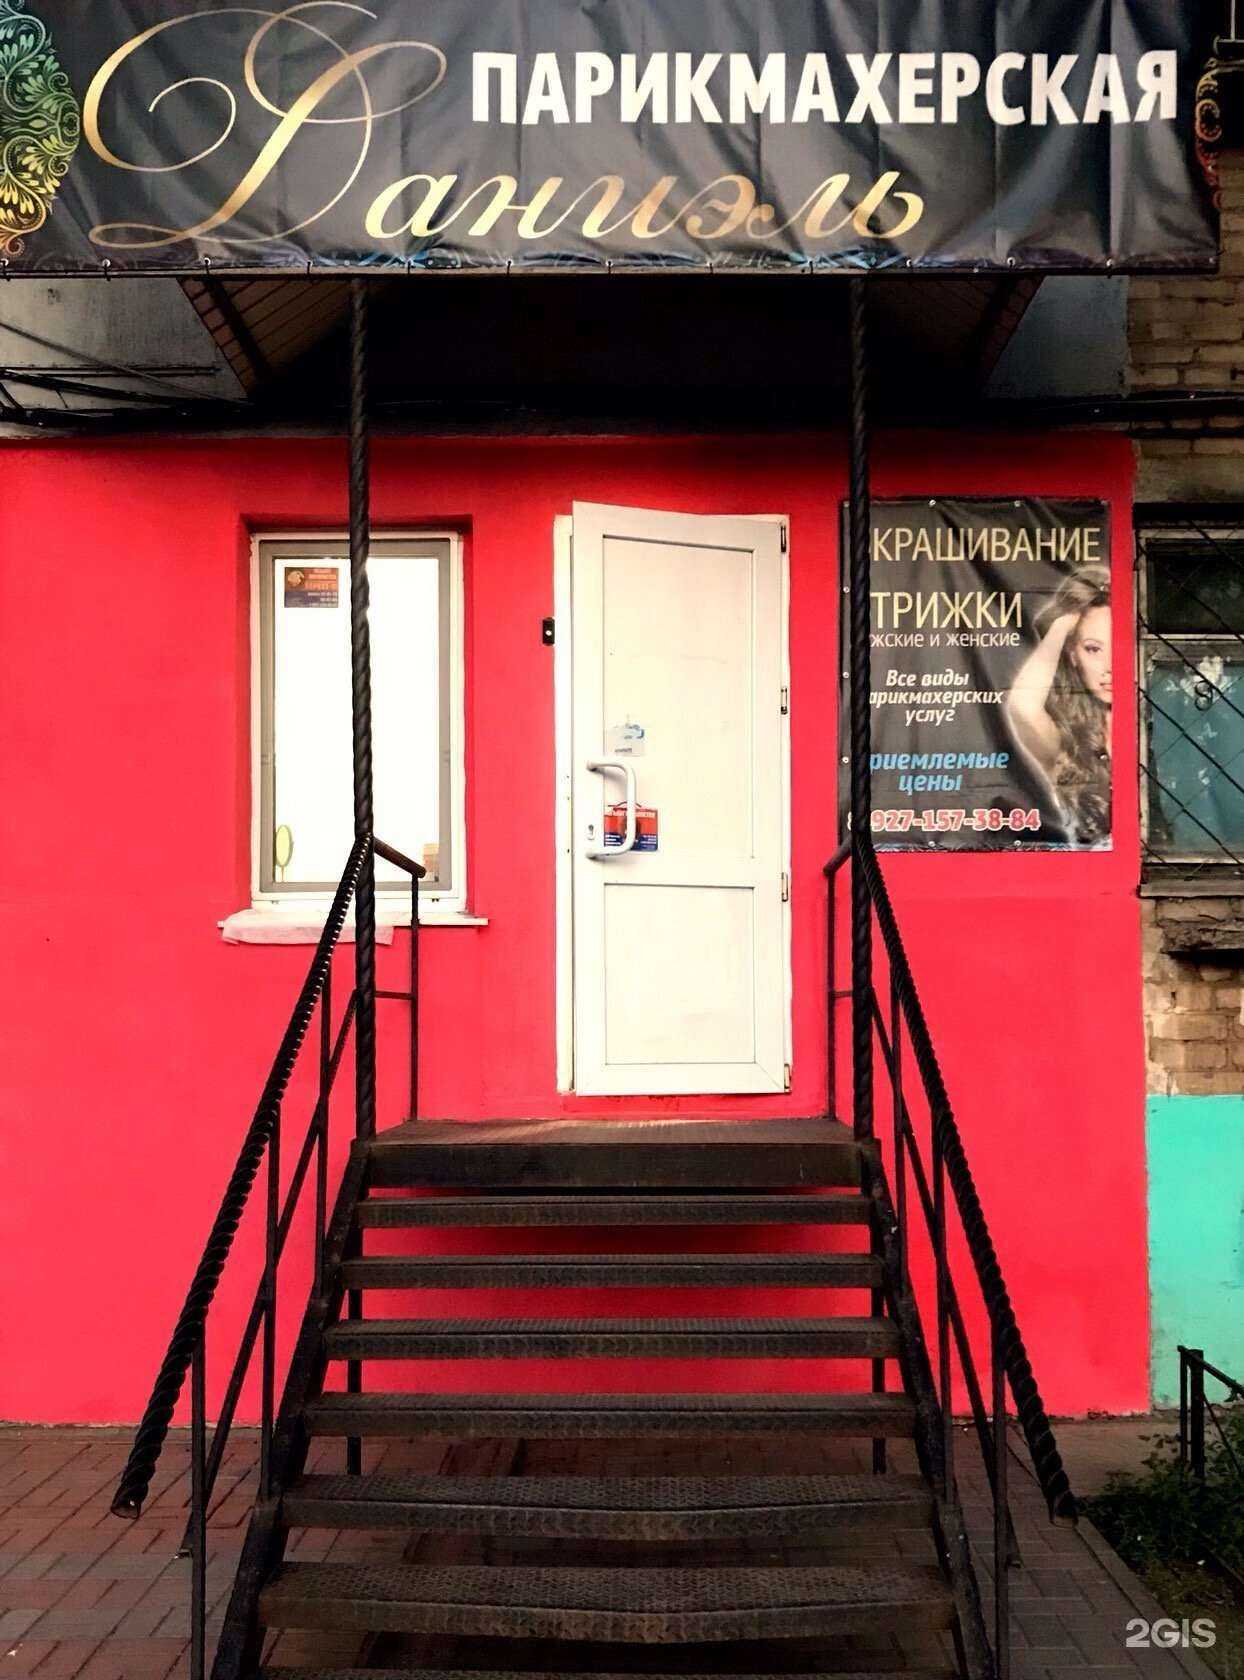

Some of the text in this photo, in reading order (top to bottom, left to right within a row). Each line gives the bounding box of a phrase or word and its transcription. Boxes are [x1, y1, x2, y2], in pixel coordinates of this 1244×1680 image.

[471, 50, 1178, 126] ПАРИКМАХЕРСКАЯ
[83, 1, 925, 249] Даниэль
[873, 528, 1101, 561] КРАШИВАНИЕ
[870, 591, 1023, 629] ТРИЖКИ
[869, 633, 1021, 648] жские и женские
[886, 668, 970, 687] Все виды
[869, 690, 1004, 709] арикмахерских
[905, 708, 956, 727] услуг
[870, 751, 1010, 774] риемлемые
[899, 773, 962, 796] цены
[847, 808, 1042, 832] 927-157-38-84
